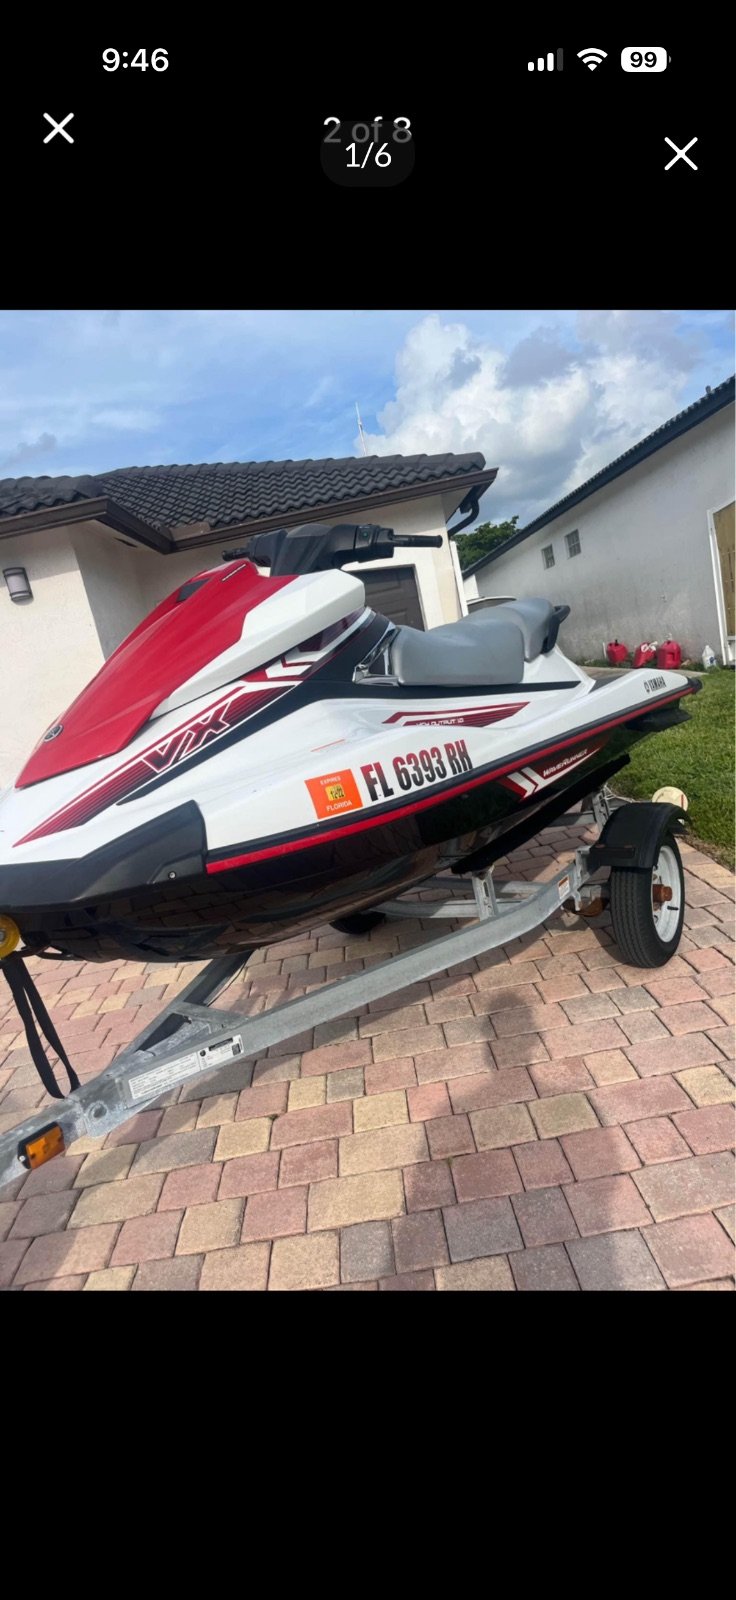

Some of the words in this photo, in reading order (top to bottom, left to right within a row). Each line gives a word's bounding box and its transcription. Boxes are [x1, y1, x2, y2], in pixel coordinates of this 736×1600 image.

[140, 700, 231, 774] VX
[320, 776, 341, 785] EXPIRES
[360, 762, 394, 802] FL
[392, 746, 447, 791] 6393
[443, 739, 474, 776] RH
[326, 800, 353, 812] FLORIDA
